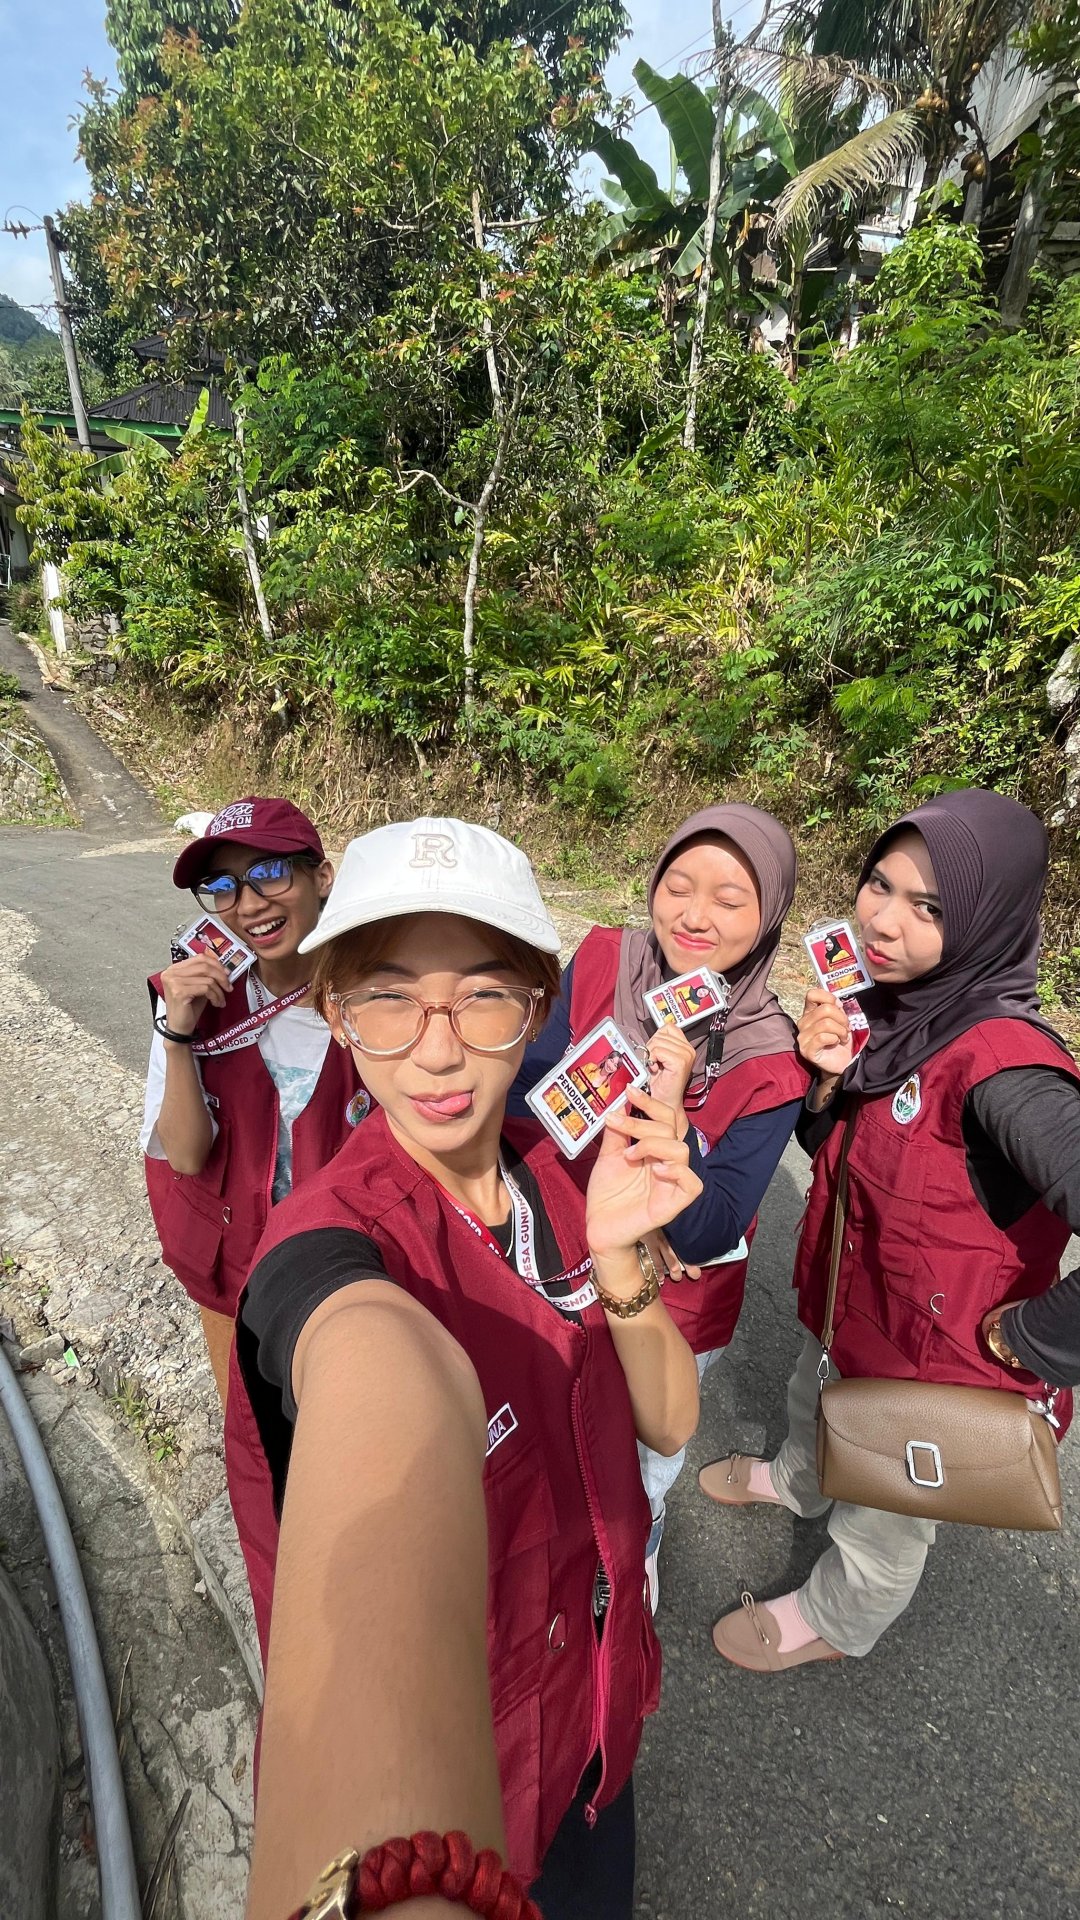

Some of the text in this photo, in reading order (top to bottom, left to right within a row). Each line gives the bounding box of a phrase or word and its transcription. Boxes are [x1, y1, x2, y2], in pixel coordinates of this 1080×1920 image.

[409, 833, 458, 868] R
[826, 965, 857, 980] EKONOMI
[281, 987, 307, 1006] UNSOED
[664, 989, 683, 1023] PENDIDIKAN
[257, 1006, 277, 1019] DESA
[557, 1073, 597, 1125] PENDIDIKAN
[521, 1249, 534, 1282] DESA
[552, 1294, 588, 1308] UNSO
